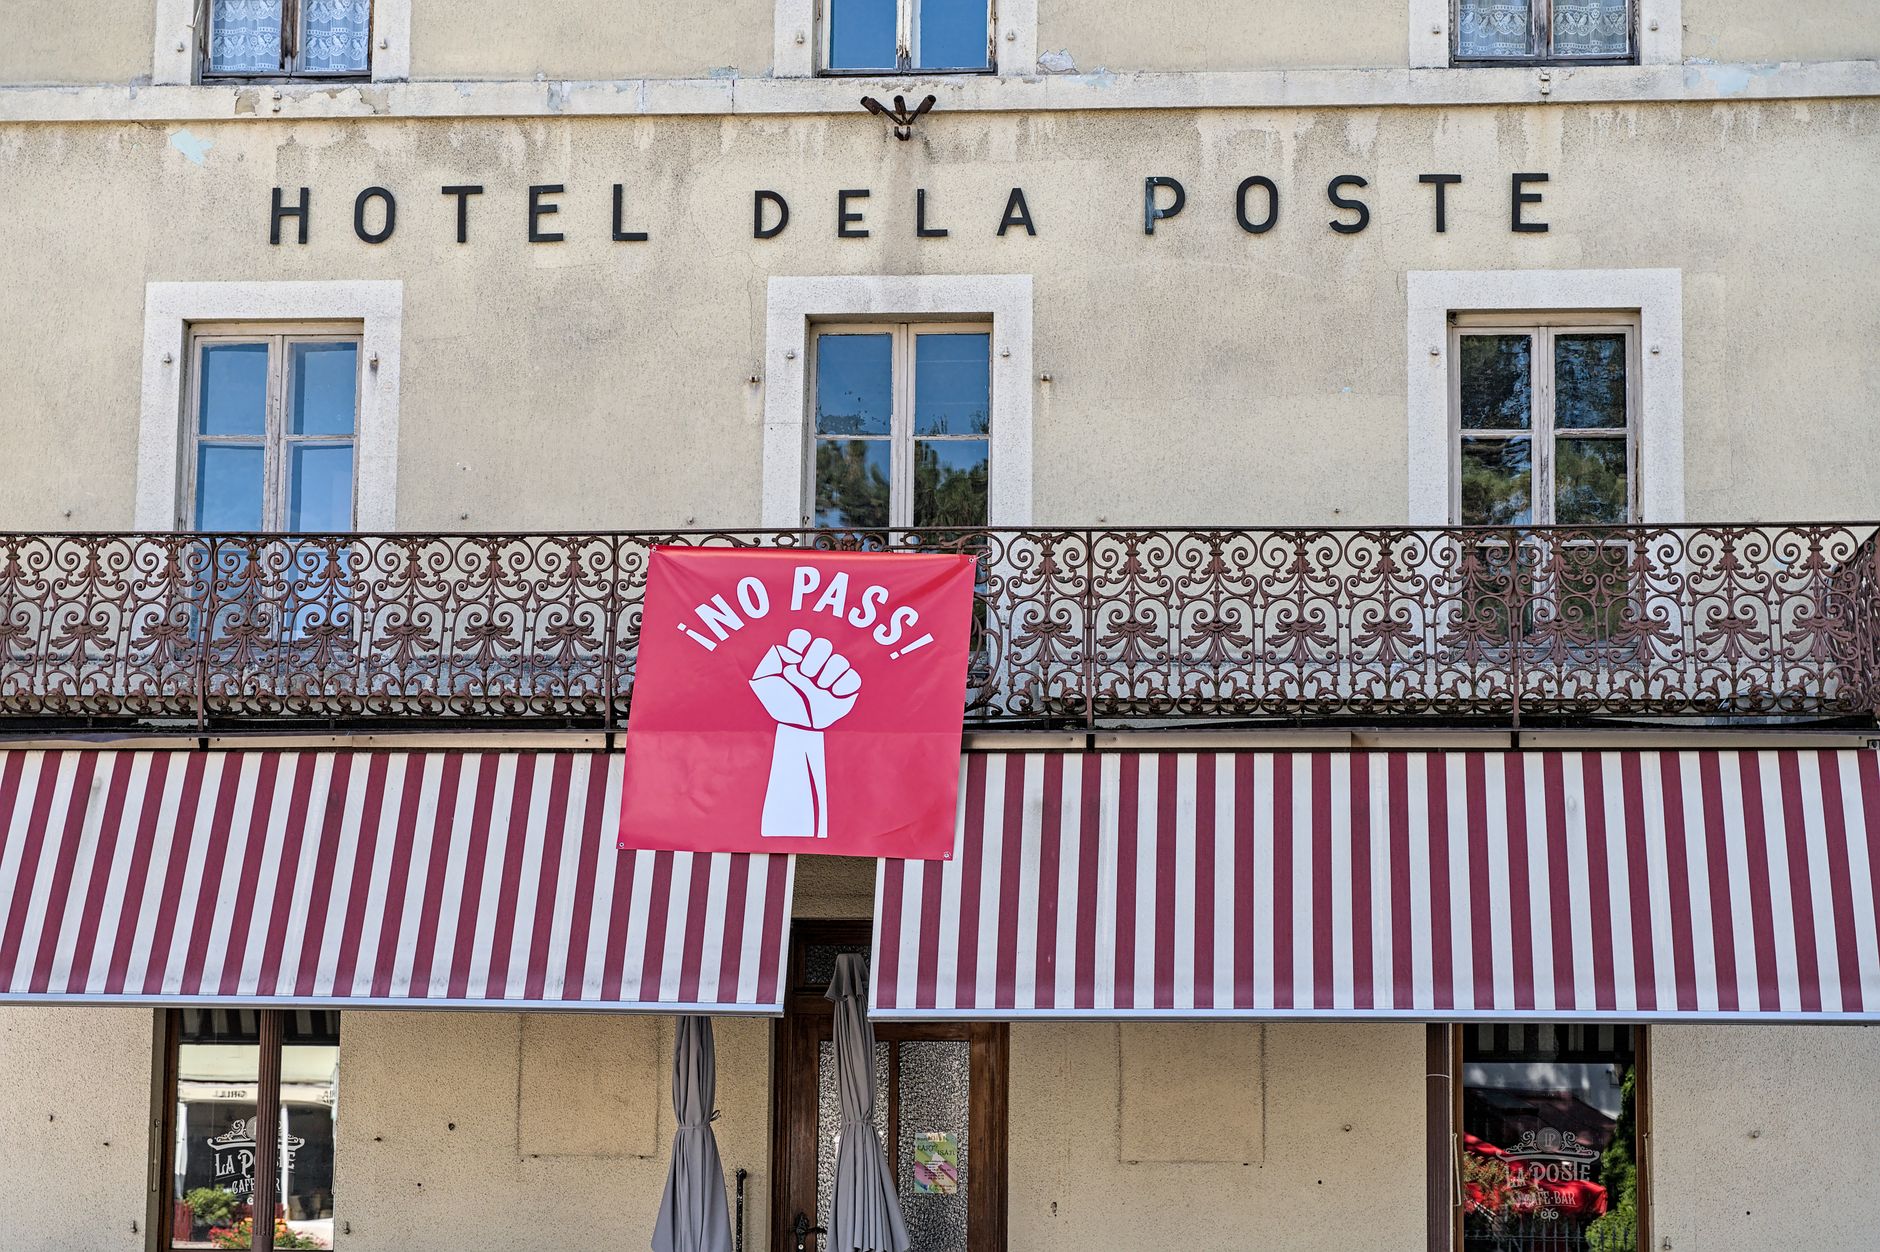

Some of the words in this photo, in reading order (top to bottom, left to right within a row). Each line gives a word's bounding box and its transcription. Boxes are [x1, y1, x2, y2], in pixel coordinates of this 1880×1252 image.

[269, 184, 648, 245] HOTEL
[1145, 173, 1549, 236] POSTE
[790, 566, 934, 660] PASS!
[214, 1153, 236, 1177] LA
[1529, 1160, 1590, 1191] POSTE
